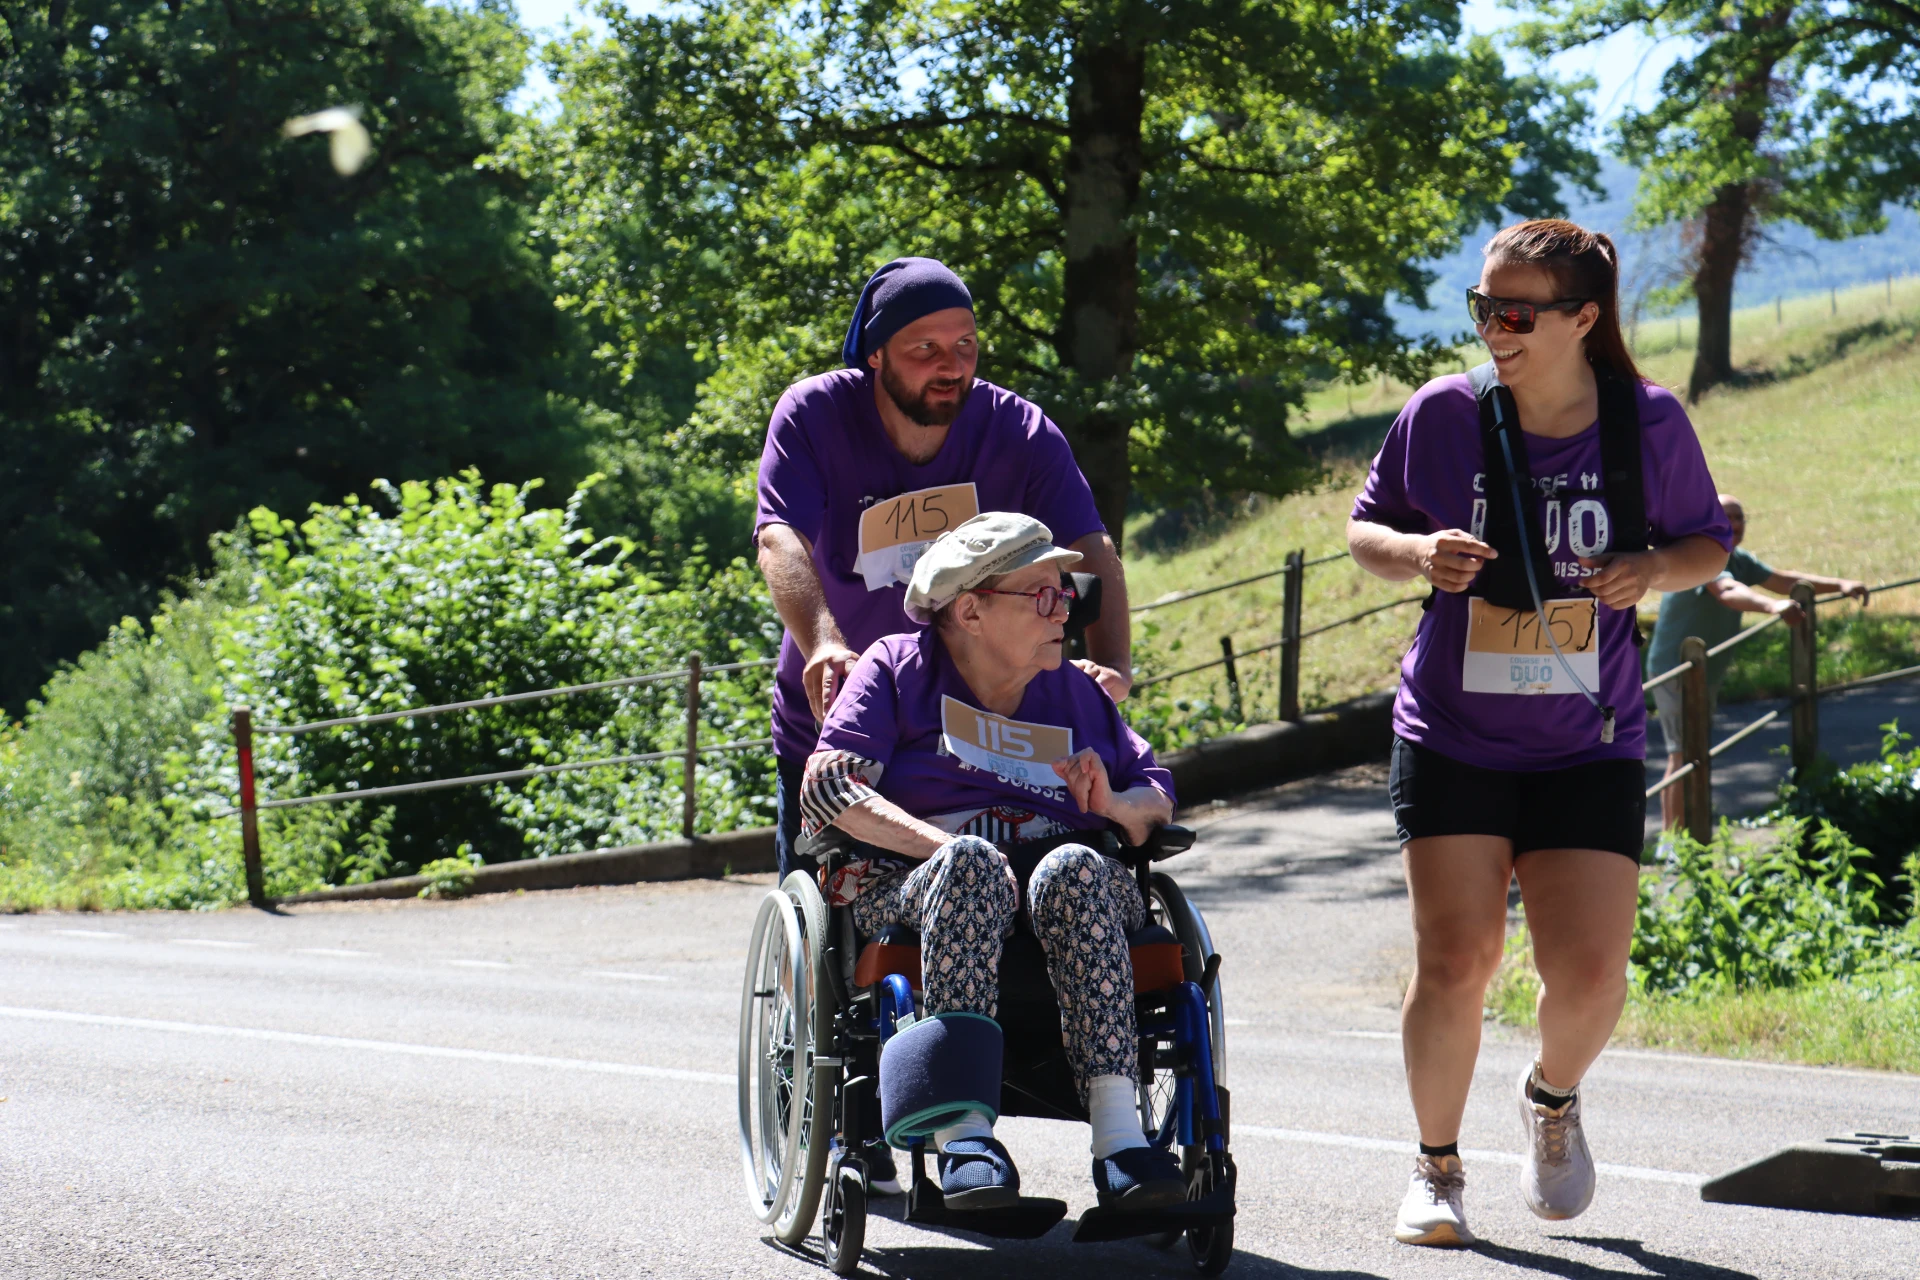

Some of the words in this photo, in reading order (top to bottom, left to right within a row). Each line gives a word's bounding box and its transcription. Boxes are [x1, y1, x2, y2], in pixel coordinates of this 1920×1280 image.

[884, 494, 948, 540] 115
[1501, 605, 1574, 650] 115
[1509, 657, 1541, 665] COURSE
[1510, 665, 1553, 683] DUO
[975, 714, 1035, 758] 115
